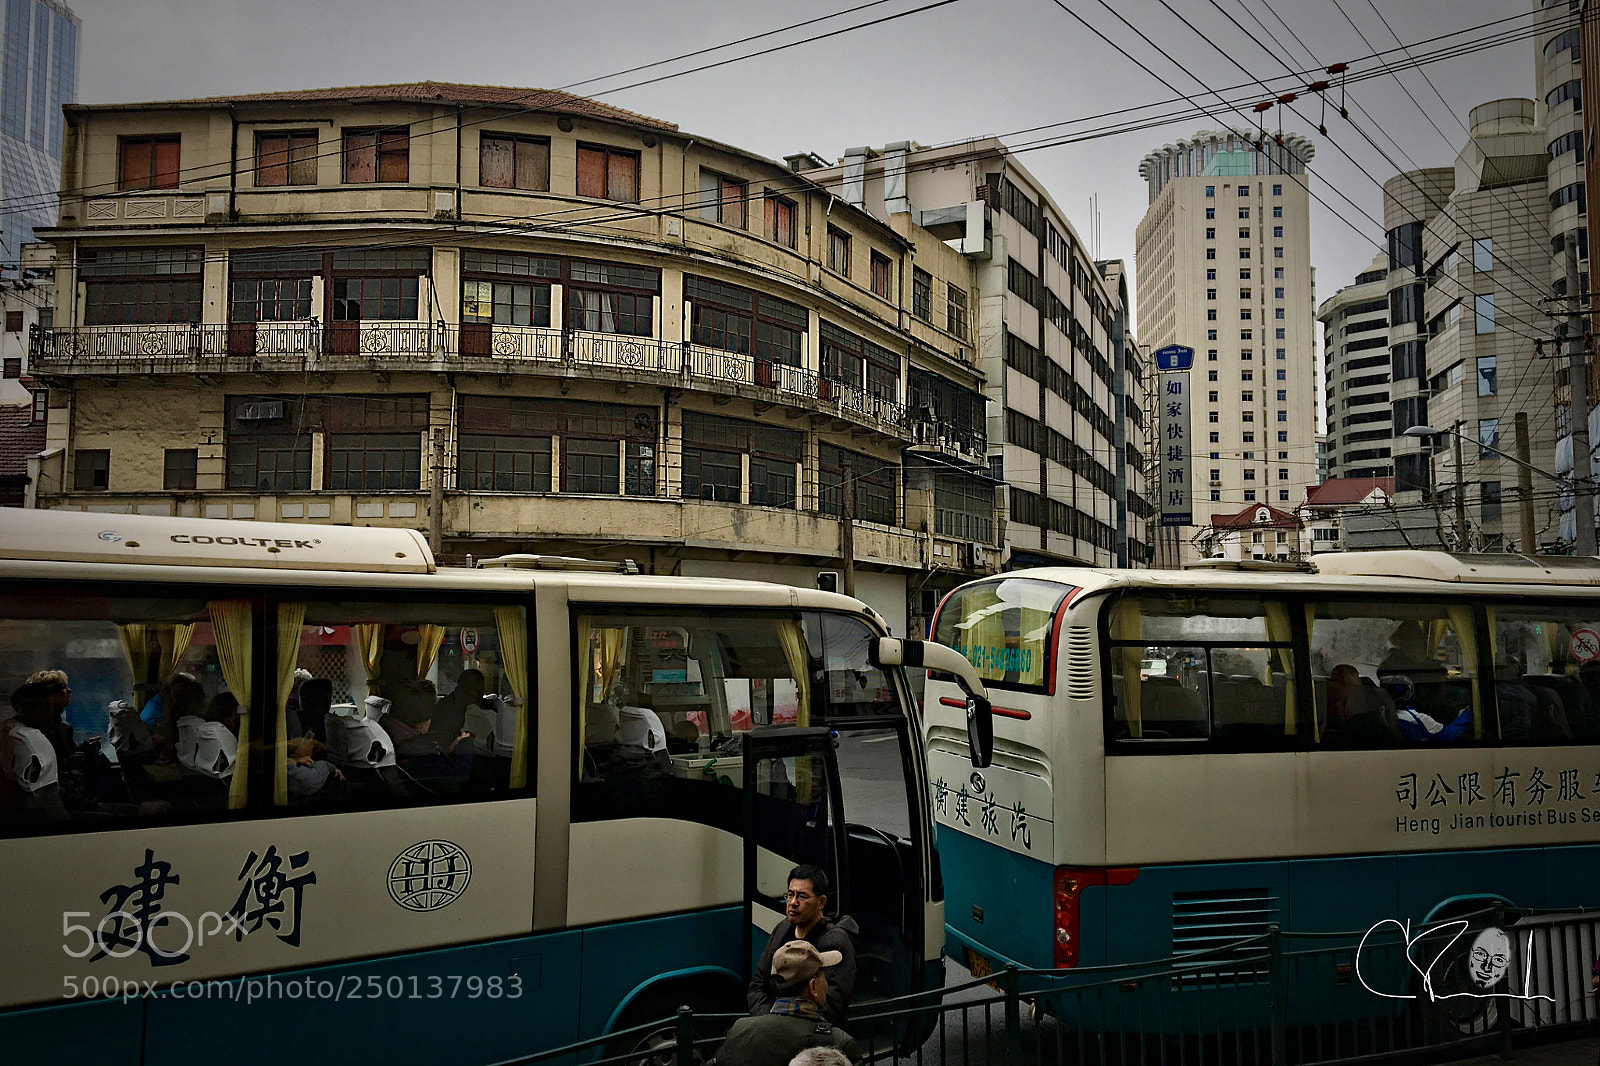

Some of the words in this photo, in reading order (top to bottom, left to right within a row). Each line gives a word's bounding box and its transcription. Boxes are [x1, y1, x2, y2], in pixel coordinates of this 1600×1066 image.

[1166, 380, 1184, 506] 如家快捷酒店
[1396, 816, 1441, 834] Heng
[1450, 813, 1485, 830] Jian
[1490, 810, 1543, 828] tourist
[1547, 809, 1577, 825] Bus
